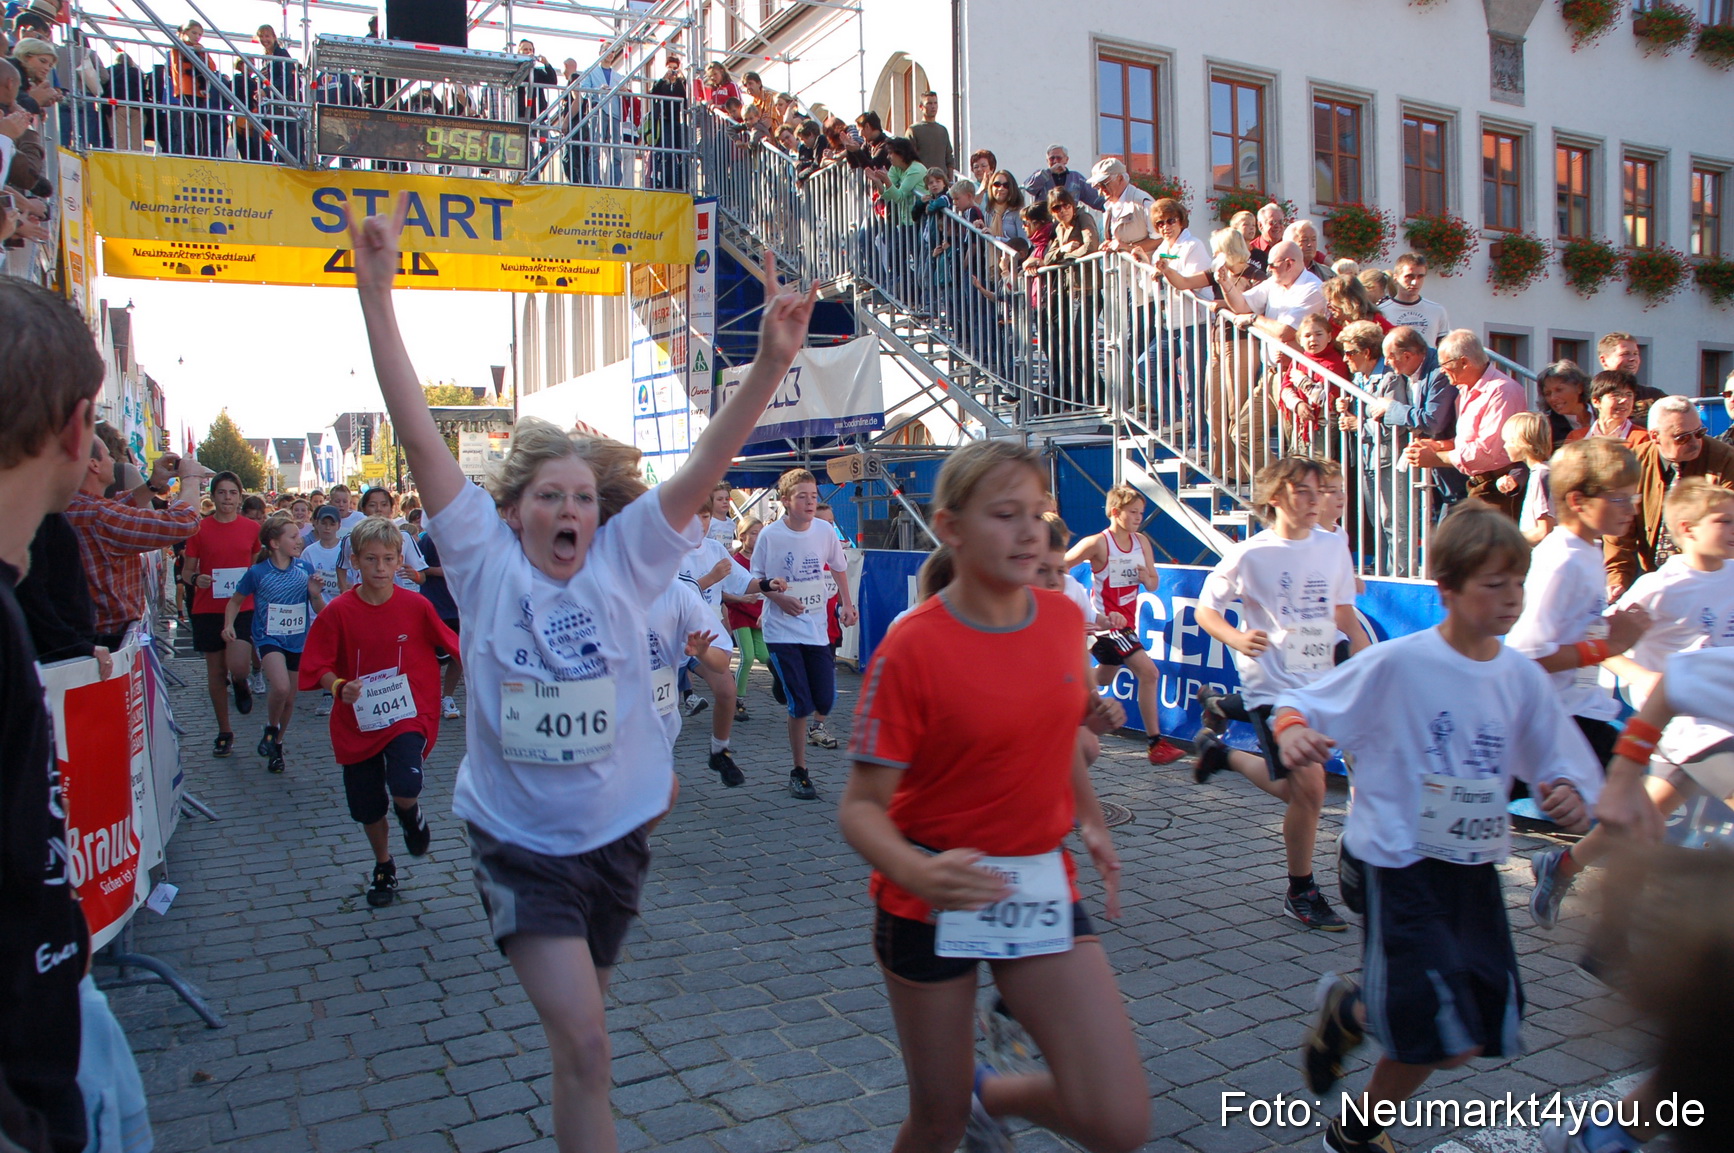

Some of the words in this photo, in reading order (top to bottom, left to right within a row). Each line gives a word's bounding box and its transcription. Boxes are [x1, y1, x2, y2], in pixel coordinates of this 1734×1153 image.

[323, 107, 370, 120] SPORTRONIC
[386, 114, 433, 126] Elektronische
[435, 119, 520, 133] Sportstätteneinrichtungen
[130, 200, 210, 216] Neumarkter
[213, 203, 273, 220] Stadtlauf
[310, 187, 513, 241] START
[549, 225, 613, 238] Neumarkter
[615, 228, 664, 241] Stadtlauf
[868, 460, 878, 473] S
[1120, 567, 1138, 578] 403
[280, 616, 304, 628] 4018
[366, 681, 403, 698] Alexander
[534, 681, 560, 699] Tim
[372, 695, 408, 716] 4041
[506, 706, 520, 721] Ju
[535, 709, 608, 738] 4016
[1451, 785, 1495, 804] Florian
[1448, 816, 1506, 841] 4093
[99, 875, 124, 896] Sicher
[120, 869, 134, 884] ist
[977, 900, 1061, 929] 4075
